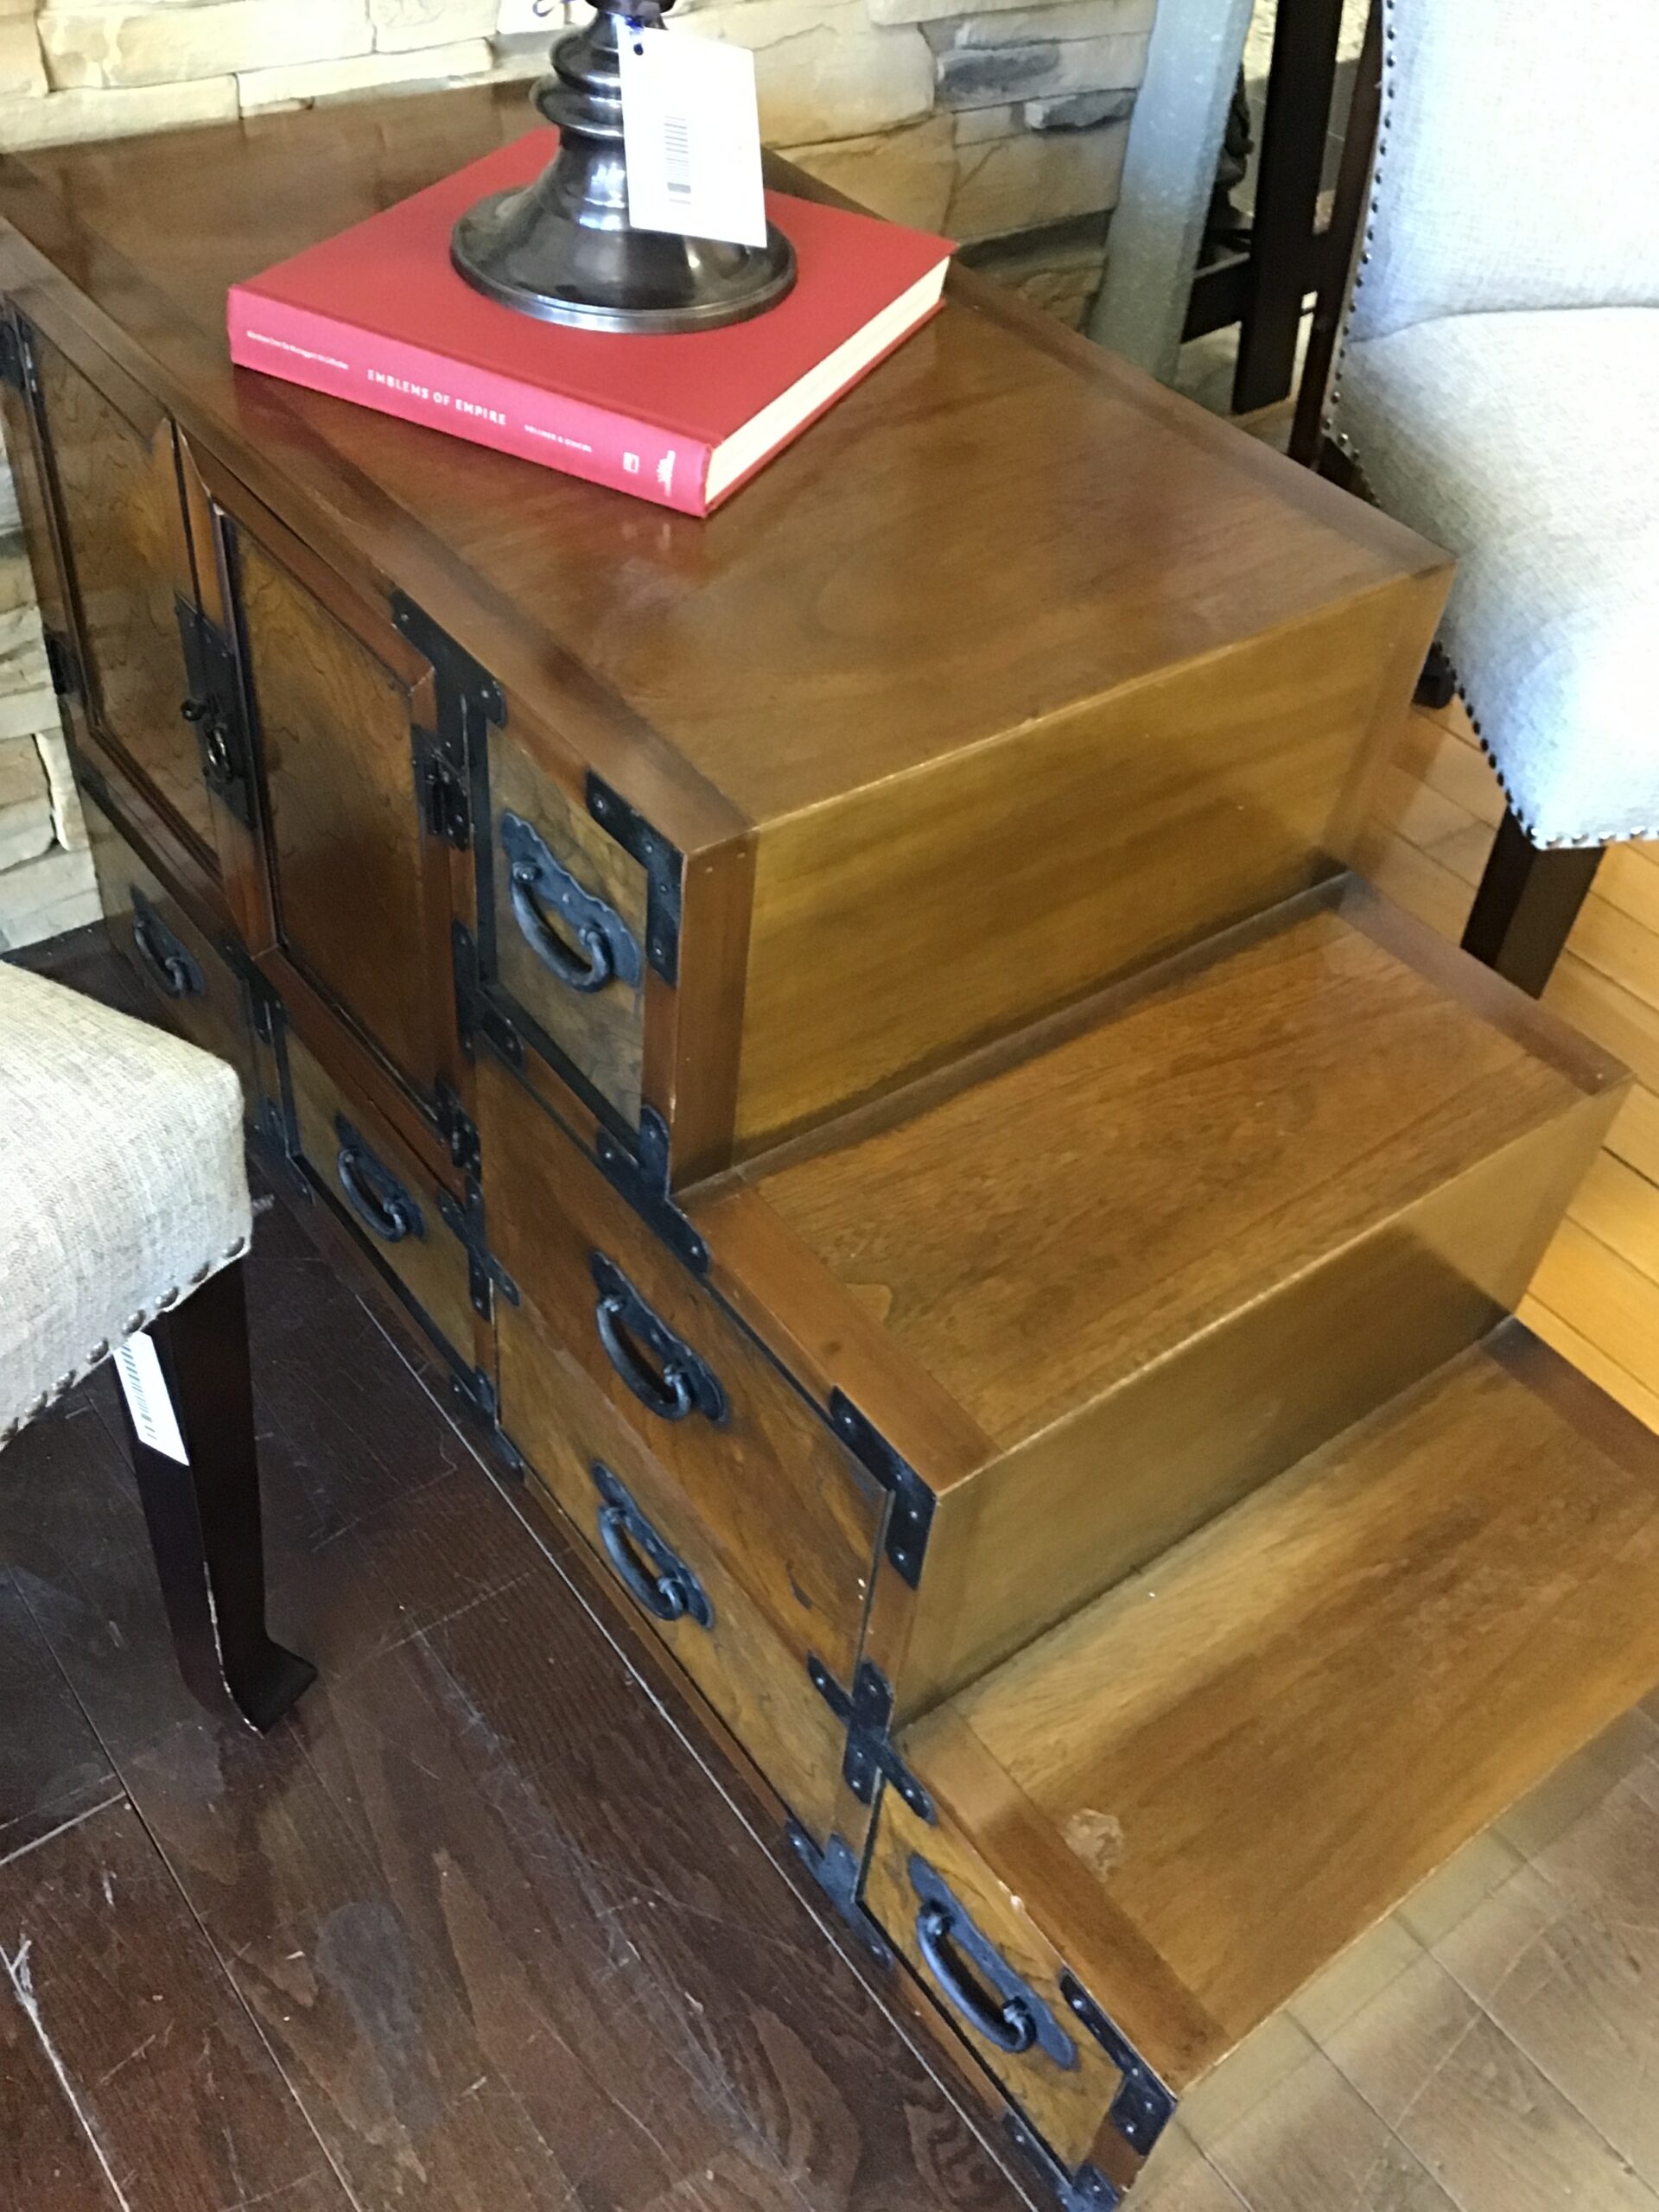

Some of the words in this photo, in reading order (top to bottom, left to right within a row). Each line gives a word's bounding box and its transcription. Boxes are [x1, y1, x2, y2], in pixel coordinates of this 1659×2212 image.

[366, 369, 429, 399] EMBLEMS
[433, 391, 451, 406] OF
[455, 397, 506, 425] EMPIRE
